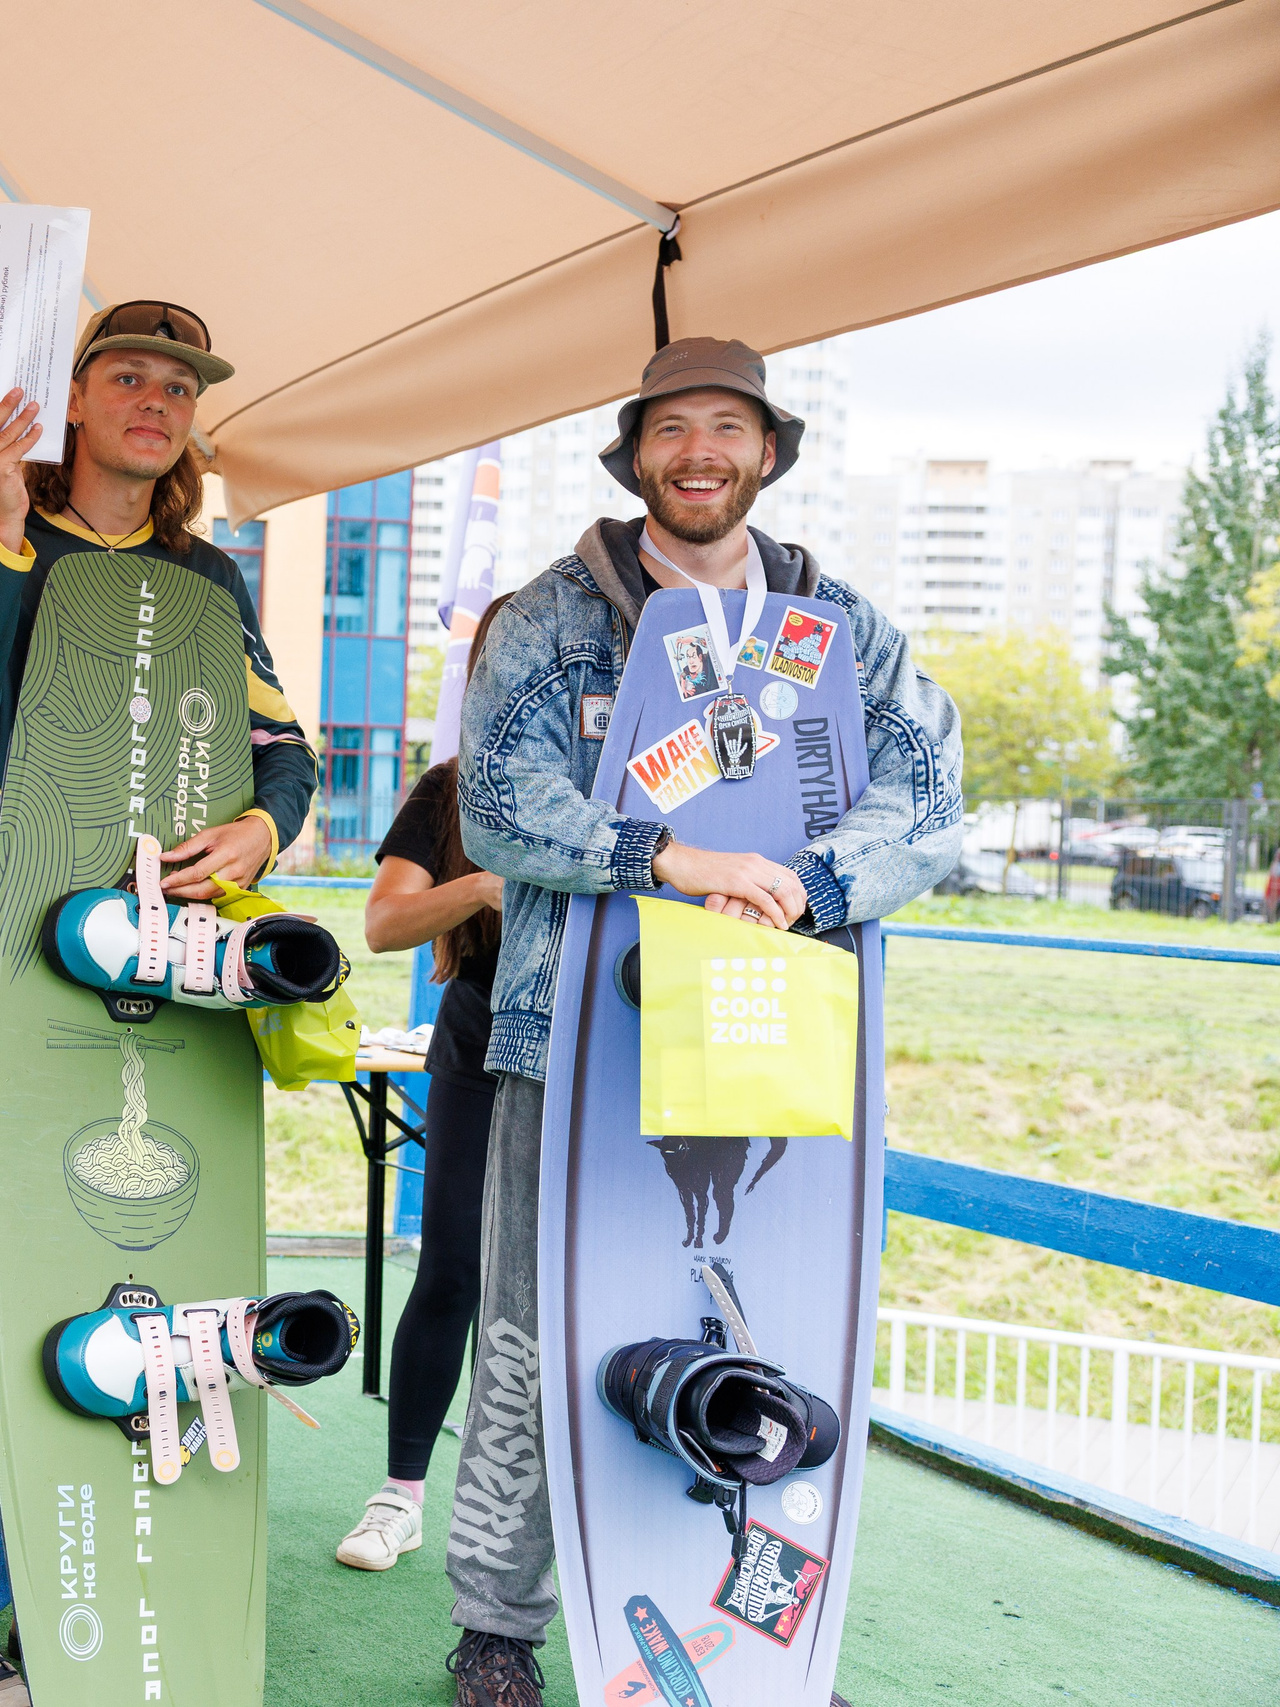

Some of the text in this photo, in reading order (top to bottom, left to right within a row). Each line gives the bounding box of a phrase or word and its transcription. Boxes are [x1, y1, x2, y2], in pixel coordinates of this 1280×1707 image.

[770, 655, 818, 685] VLADIVOSTOK
[128, 580, 155, 838] LOCAL LOCAL
[174, 736, 191, 837] на воде
[633, 724, 705, 792] WAKE
[655, 744, 721, 808] TRAIN
[710, 996, 787, 1019] COOL
[710, 1022, 788, 1044] ZONE
[180, 1416, 204, 1447] DIRTY
[131, 1441, 153, 1563] LOCAL
[57, 1484, 79, 1600] КРУГИ
[80, 1483, 97, 1599] на воде
